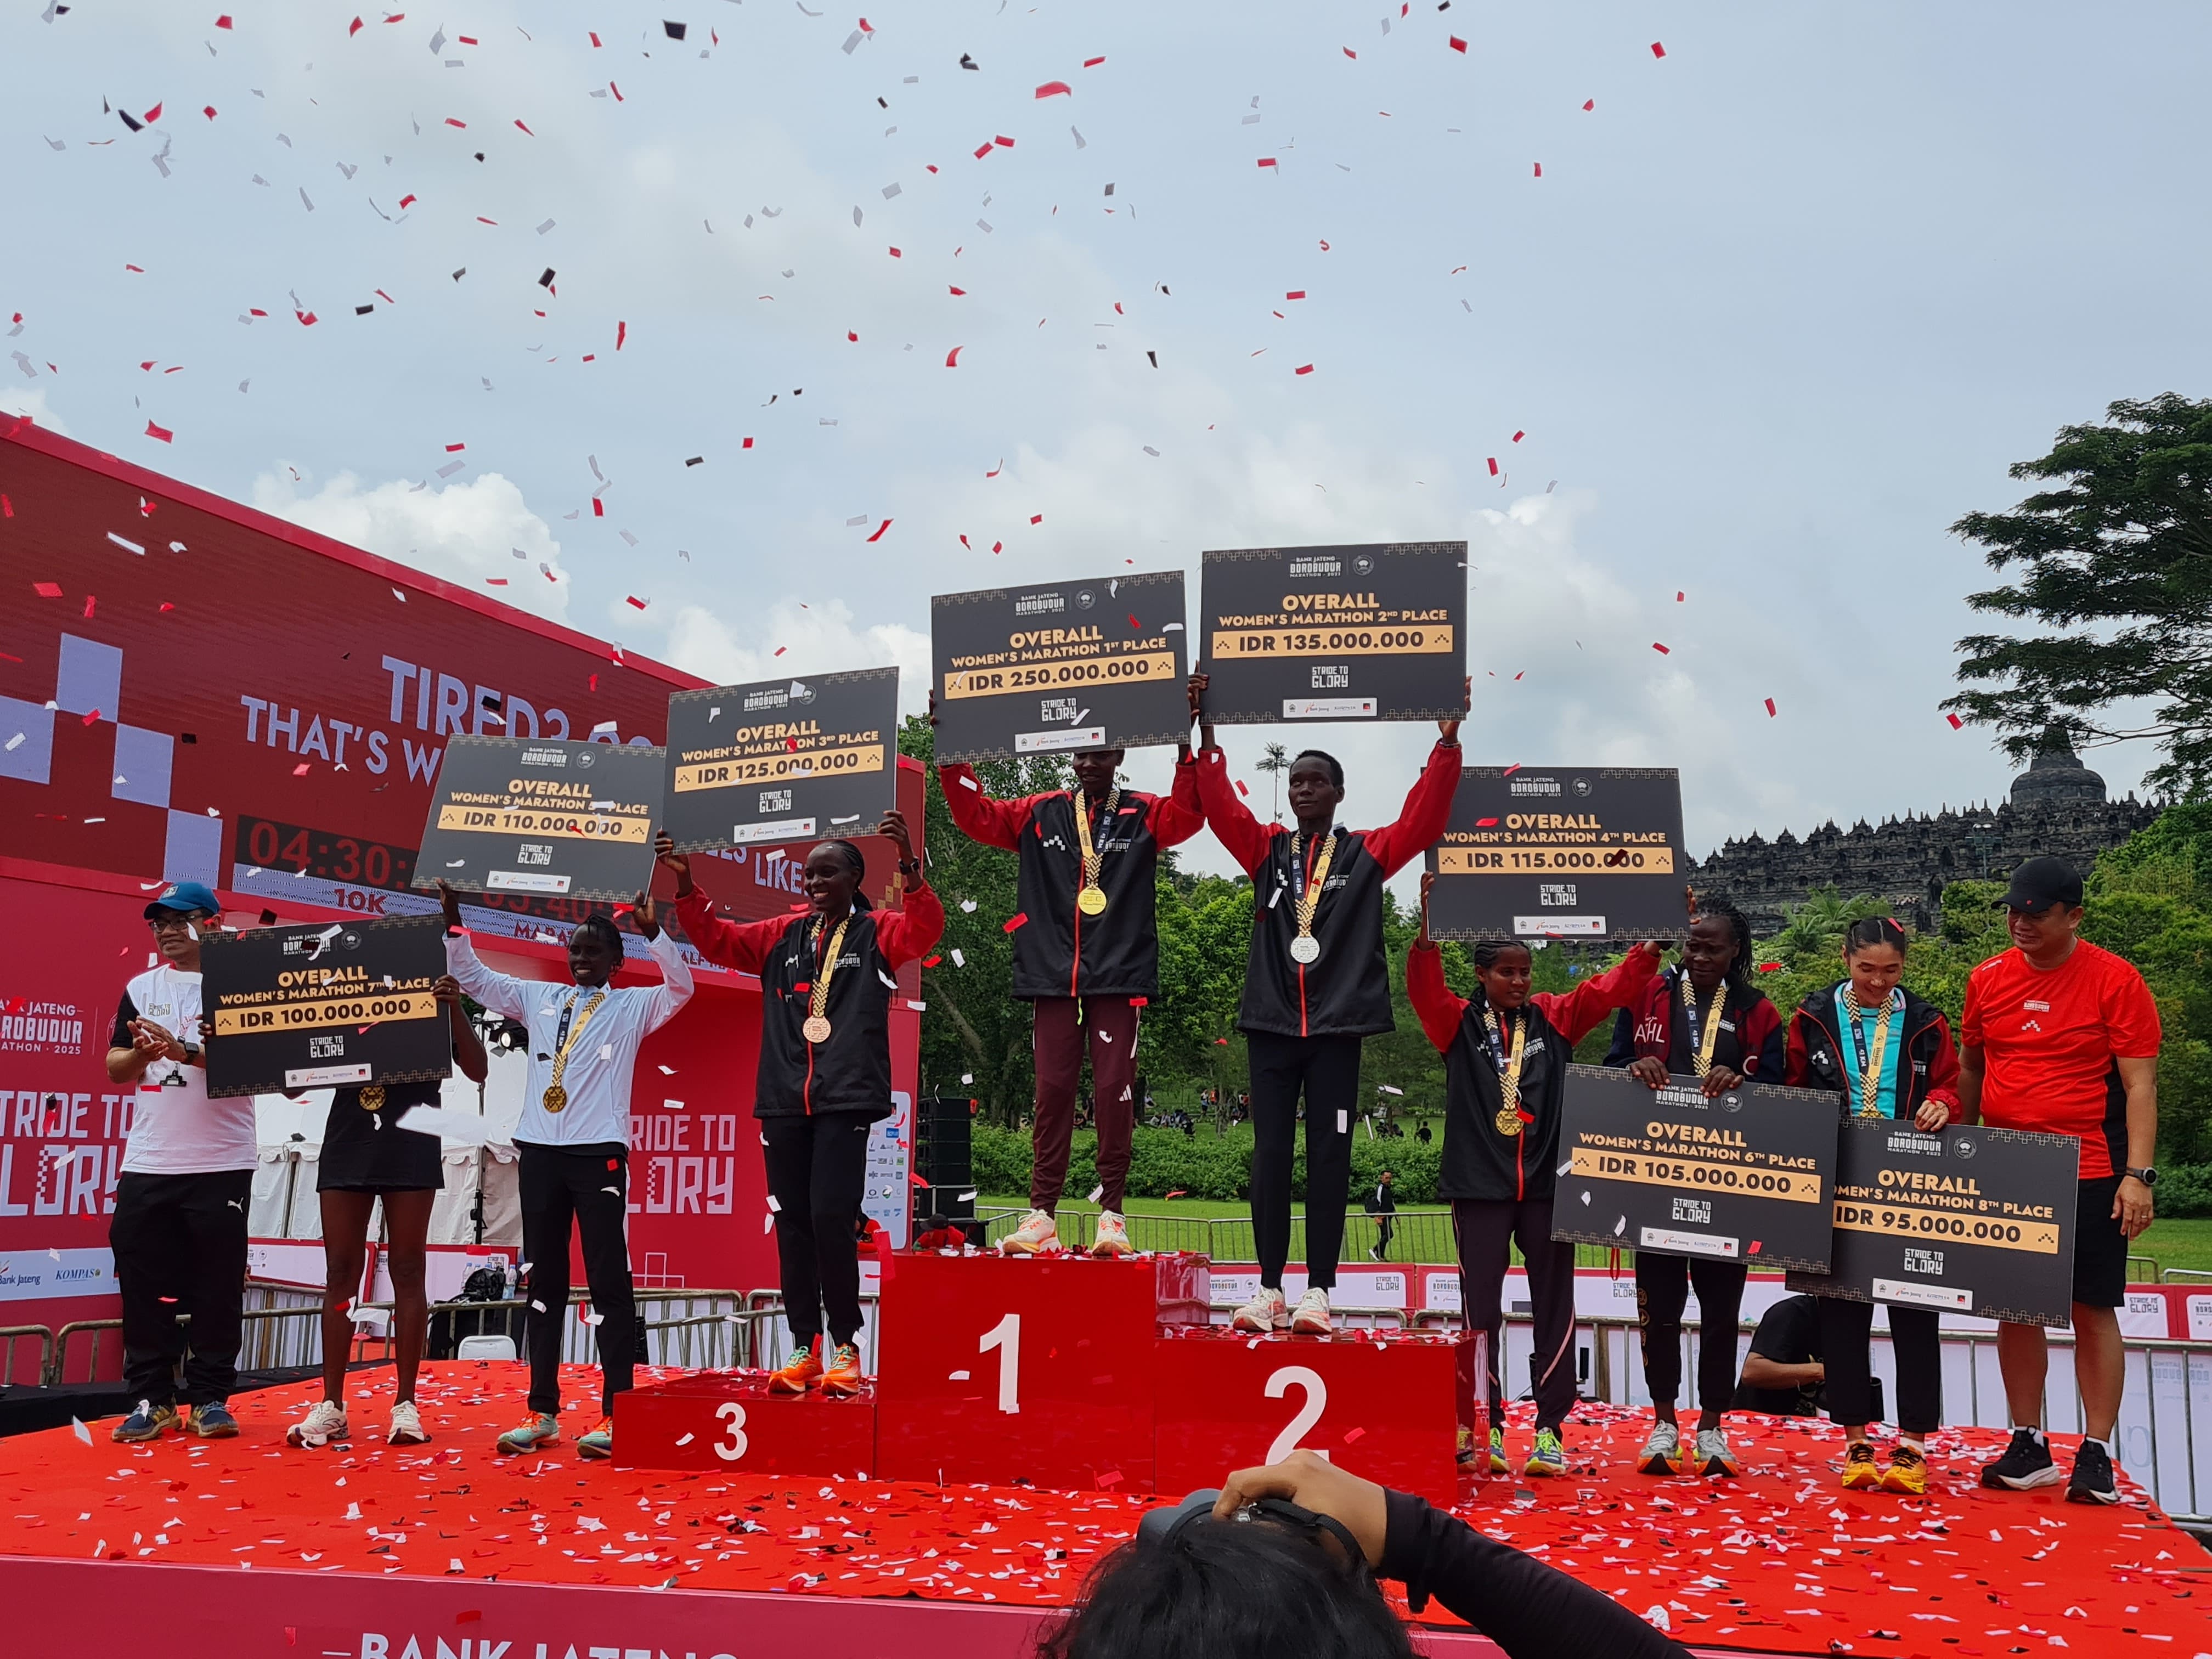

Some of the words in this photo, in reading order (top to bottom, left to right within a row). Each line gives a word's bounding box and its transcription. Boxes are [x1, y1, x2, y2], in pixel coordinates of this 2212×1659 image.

[1290, 561, 1341, 573] BOROBUDUR
[1015, 597, 1064, 612] BOROBUDUR
[1282, 592, 1380, 612] OVERALL
[1218, 613, 1288, 627] WOMEN'S
[1291, 610, 1373, 625] MARATHON
[1378, 610, 1397, 622] 2ND
[1402, 608, 1447, 622] PLACE
[1009, 624, 1103, 650] OVERALL
[1239, 635, 1275, 652] IDR
[1283, 630, 1423, 651] 135.000.000
[949, 650, 1017, 669] WOMEN'S
[1018, 642, 1099, 662] MARATHON
[1105, 641, 1118, 653] 1ST
[1122, 636, 1166, 652] PLACE
[969, 673, 1003, 691] IDR
[1011, 659, 1149, 687] 250.000.000
[1312, 665, 1337, 675] STRIDE
[1339, 665, 1348, 674] TO
[1311, 674, 1348, 688] GLORY
[744, 693, 788, 708] BOROBUDUR
[1041, 698, 1065, 709] STRIDE
[1066, 697, 1076, 706] TO
[1041, 706, 1076, 721] GLORY
[241, 695, 388, 774] THAT'S
[736, 719, 821, 743] OVERALL
[682, 744, 741, 763] WOMEN'S
[744, 736, 815, 755] MARATON
[820, 734, 834, 747] 3RD
[838, 729, 878, 745] PLACE
[698, 766, 728, 784] IDR
[735, 752, 857, 780] 125.000.000
[507, 779, 595, 799] OVERALL
[759, 790, 782, 800] STRIDE
[783, 789, 792, 798] TO
[1510, 782, 1561, 792] BOROBUDUR
[449, 791, 511, 805] WOMEN'S
[513, 795, 586, 810] MARATHON
[759, 798, 791, 813] GLORY
[462, 811, 496, 827] IDR
[500, 814, 623, 836] 110.000000
[1505, 814, 1601, 830] OVERALL
[1443, 831, 1513, 843] WOMEN'S
[1516, 831, 1596, 843] MARATHON
[1600, 831, 1619, 843] 4TH
[1622, 831, 1665, 843] PLACE
[520, 844, 544, 853] STRIDE
[517, 851, 551, 865] GLORY
[1467, 853, 1503, 868] IDR
[1539, 884, 1565, 893] STRIDE
[1566, 884, 1576, 893] TO
[334, 888, 387, 915] 10K
[1540, 893, 1577, 906] GLORY
[219, 989, 285, 1006] WOMEN'S
[288, 982, 364, 1000] MARATHON
[368, 980, 385, 993] 7TH
[388, 976, 430, 991] PLACE
[27, 1001, 76, 1016] JATENG
[240, 1010, 274, 1028] IDR
[280, 998, 411, 1025] 100.000.000
[1, 1015, 83, 1044] ROBUDUR
[1634, 1023, 1666, 1043] AHL
[1, 1041, 42, 1053] ATHON
[54, 1045, 81, 1054] 2025
[309, 1036, 333, 1046] STRIDE
[334, 1035, 343, 1043] TO
[310, 1043, 344, 1058] GLORY
[1656, 1089, 1709, 1105] BOROBUDUR
[0, 1090, 92, 1139] TRIDE
[628, 1115, 691, 1152] RIDE
[700, 1114, 736, 1152] TO
[1645, 1121, 1748, 1149] OVERALL
[1579, 1131, 1651, 1152] WOMEN'S
[1655, 1140, 1740, 1162] MARATHON
[1744, 1150, 1765, 1165] 6TH
[1768, 1153, 1815, 1170] PLACE
[1887, 1136, 1942, 1152] BOROBUDUR
[0, 1143, 121, 1216] LORY
[1599, 1155, 1637, 1176] IDR
[1644, 1161, 1791, 1194] 105.000.000
[1877, 1169, 1981, 1197] OVERALL
[627, 1156, 735, 1215] ORY
[1673, 1197, 1700, 1209] STRIDE
[1701, 1200, 1711, 1210] TO
[1834, 1183, 1883, 1200] MEN'S
[1887, 1188, 1974, 1210] MARATHON
[1978, 1198, 1999, 1213] 8TH
[2002, 1200, 2053, 1219] PLACE
[1672, 1206, 1710, 1224] GLORY
[1835, 1205, 1874, 1226] IDR
[1881, 1210, 2021, 1243] 95.000.000
[1905, 1248, 1932, 1260] STRIDE
[1933, 1251, 1944, 1261] TO
[55, 1268, 95, 1280] KOMPAS
[1904, 1257, 1943, 1275] GLORY
[17, 1274, 41, 1286] Jateng
[1375, 1283, 1400, 1291] GLORY
[2130, 1304, 2159, 1314] GLORY
[979, 1313, 1020, 1412] 1
[1263, 1365, 1330, 1466] 2
[713, 1402, 748, 1461] 3
